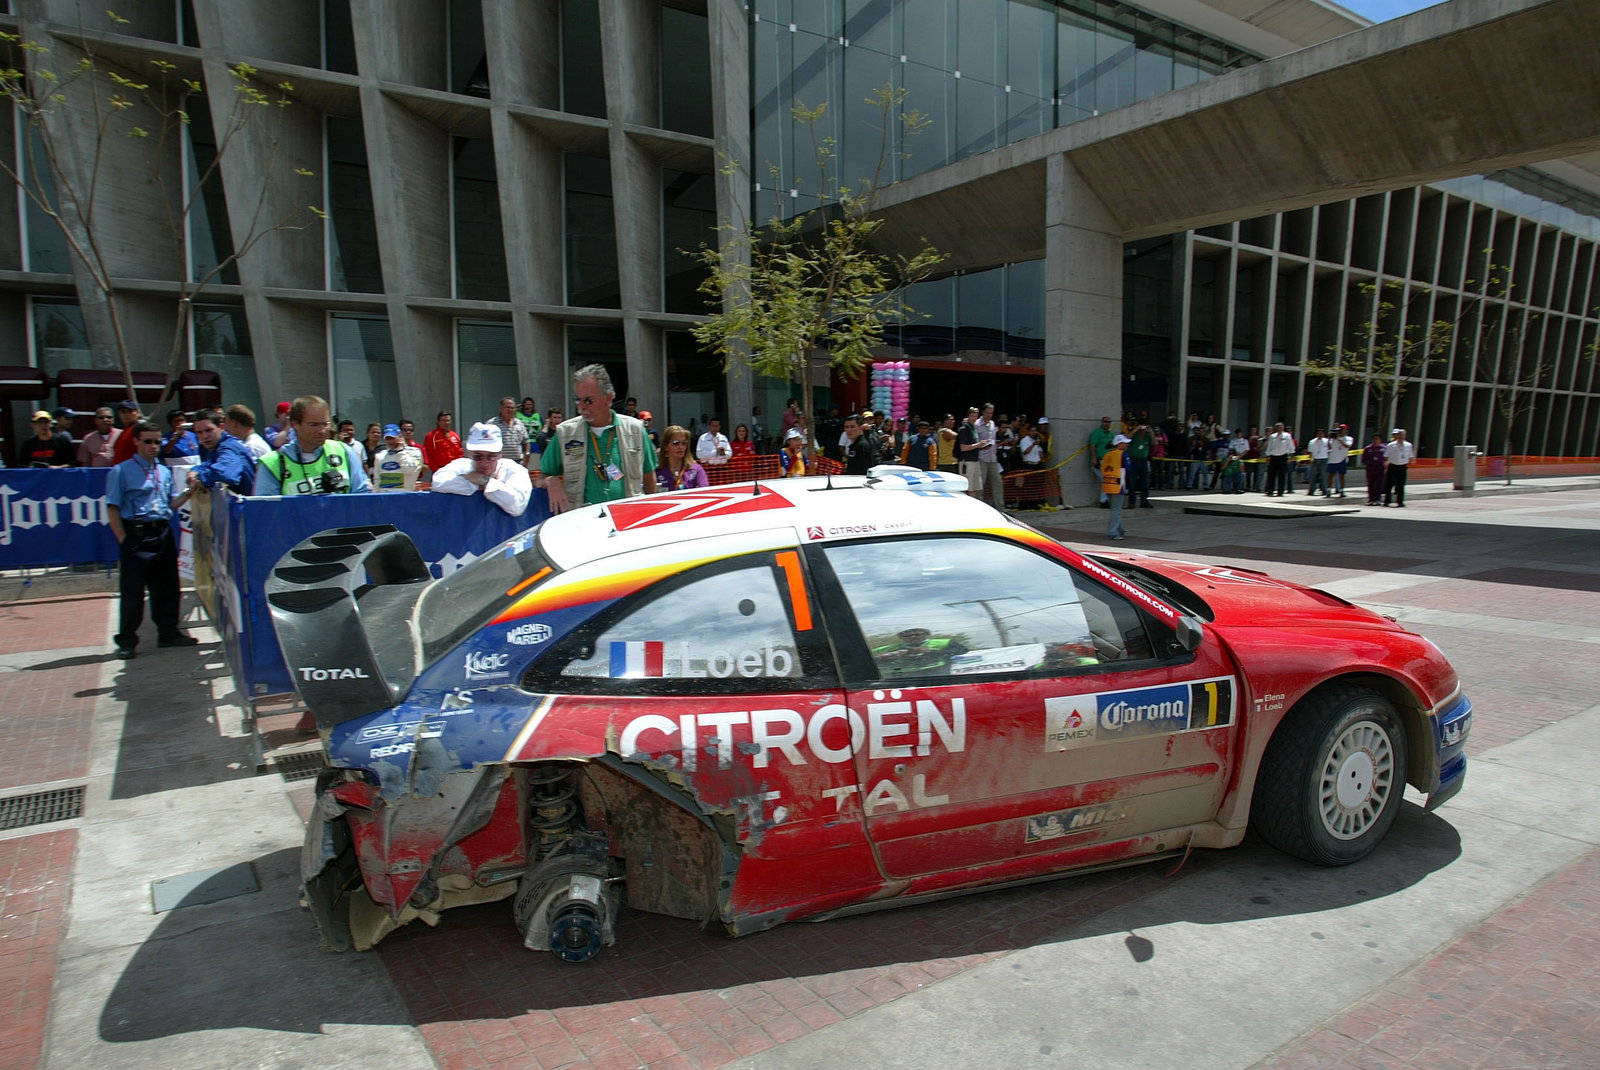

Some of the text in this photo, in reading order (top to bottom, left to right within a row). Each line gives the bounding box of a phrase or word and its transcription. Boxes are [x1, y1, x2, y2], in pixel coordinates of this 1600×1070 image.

[775, 551, 813, 631] 1
[680, 640, 792, 678] Loeb
[1101, 699, 1185, 732] Corona
[1204, 682, 1218, 726] 1
[1048, 728, 1094, 742] PEMEX
